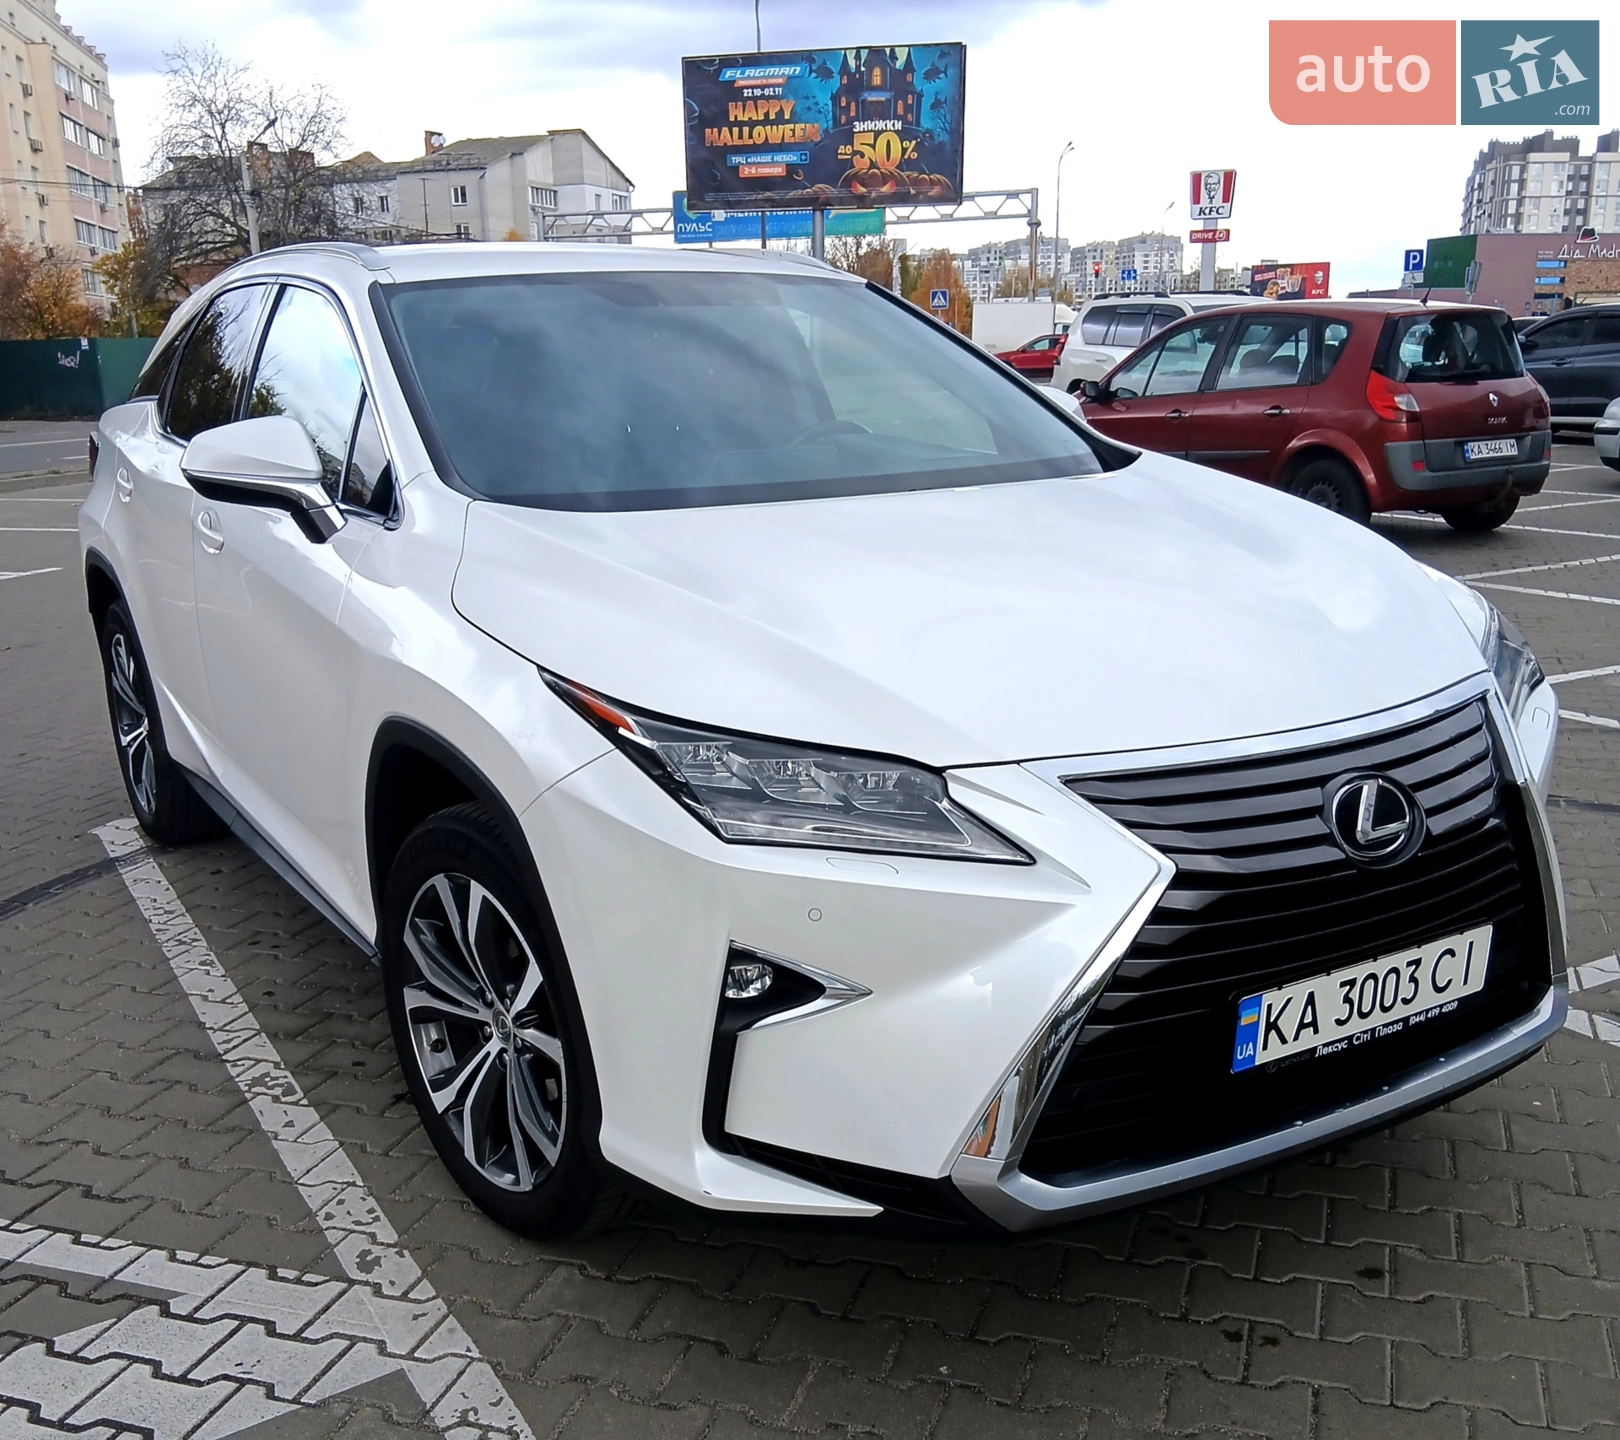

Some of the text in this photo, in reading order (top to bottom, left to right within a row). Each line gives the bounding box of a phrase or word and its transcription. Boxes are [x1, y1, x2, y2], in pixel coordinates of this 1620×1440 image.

[725, 66, 801, 79] FLAGMAN
[728, 99, 796, 121] HAPPY
[852, 119, 902, 132] ЗНИЖКИ
[705, 123, 821, 147] HALLOWEEN
[1198, 206, 1225, 216] KFC
[677, 222, 713, 233] ПУЛЬС
[1192, 232, 1214, 240] DRIVE
[1409, 252, 1421, 271] P
[1469, 444, 1484, 456] KA
[1485, 442, 1503, 455] 3466
[1261, 991, 1320, 1051] KA
[1333, 956, 1422, 1027] 3003
[1315, 1039, 1348, 1058] Лексус
[1375, 1021, 1404, 1038] Плаза
[1409, 1012, 1426, 1026] (044)
[1427, 1006, 1440, 1019] 499
[1441, 1001, 1459, 1015] 4009
[1236, 1042, 1254, 1060] UA
